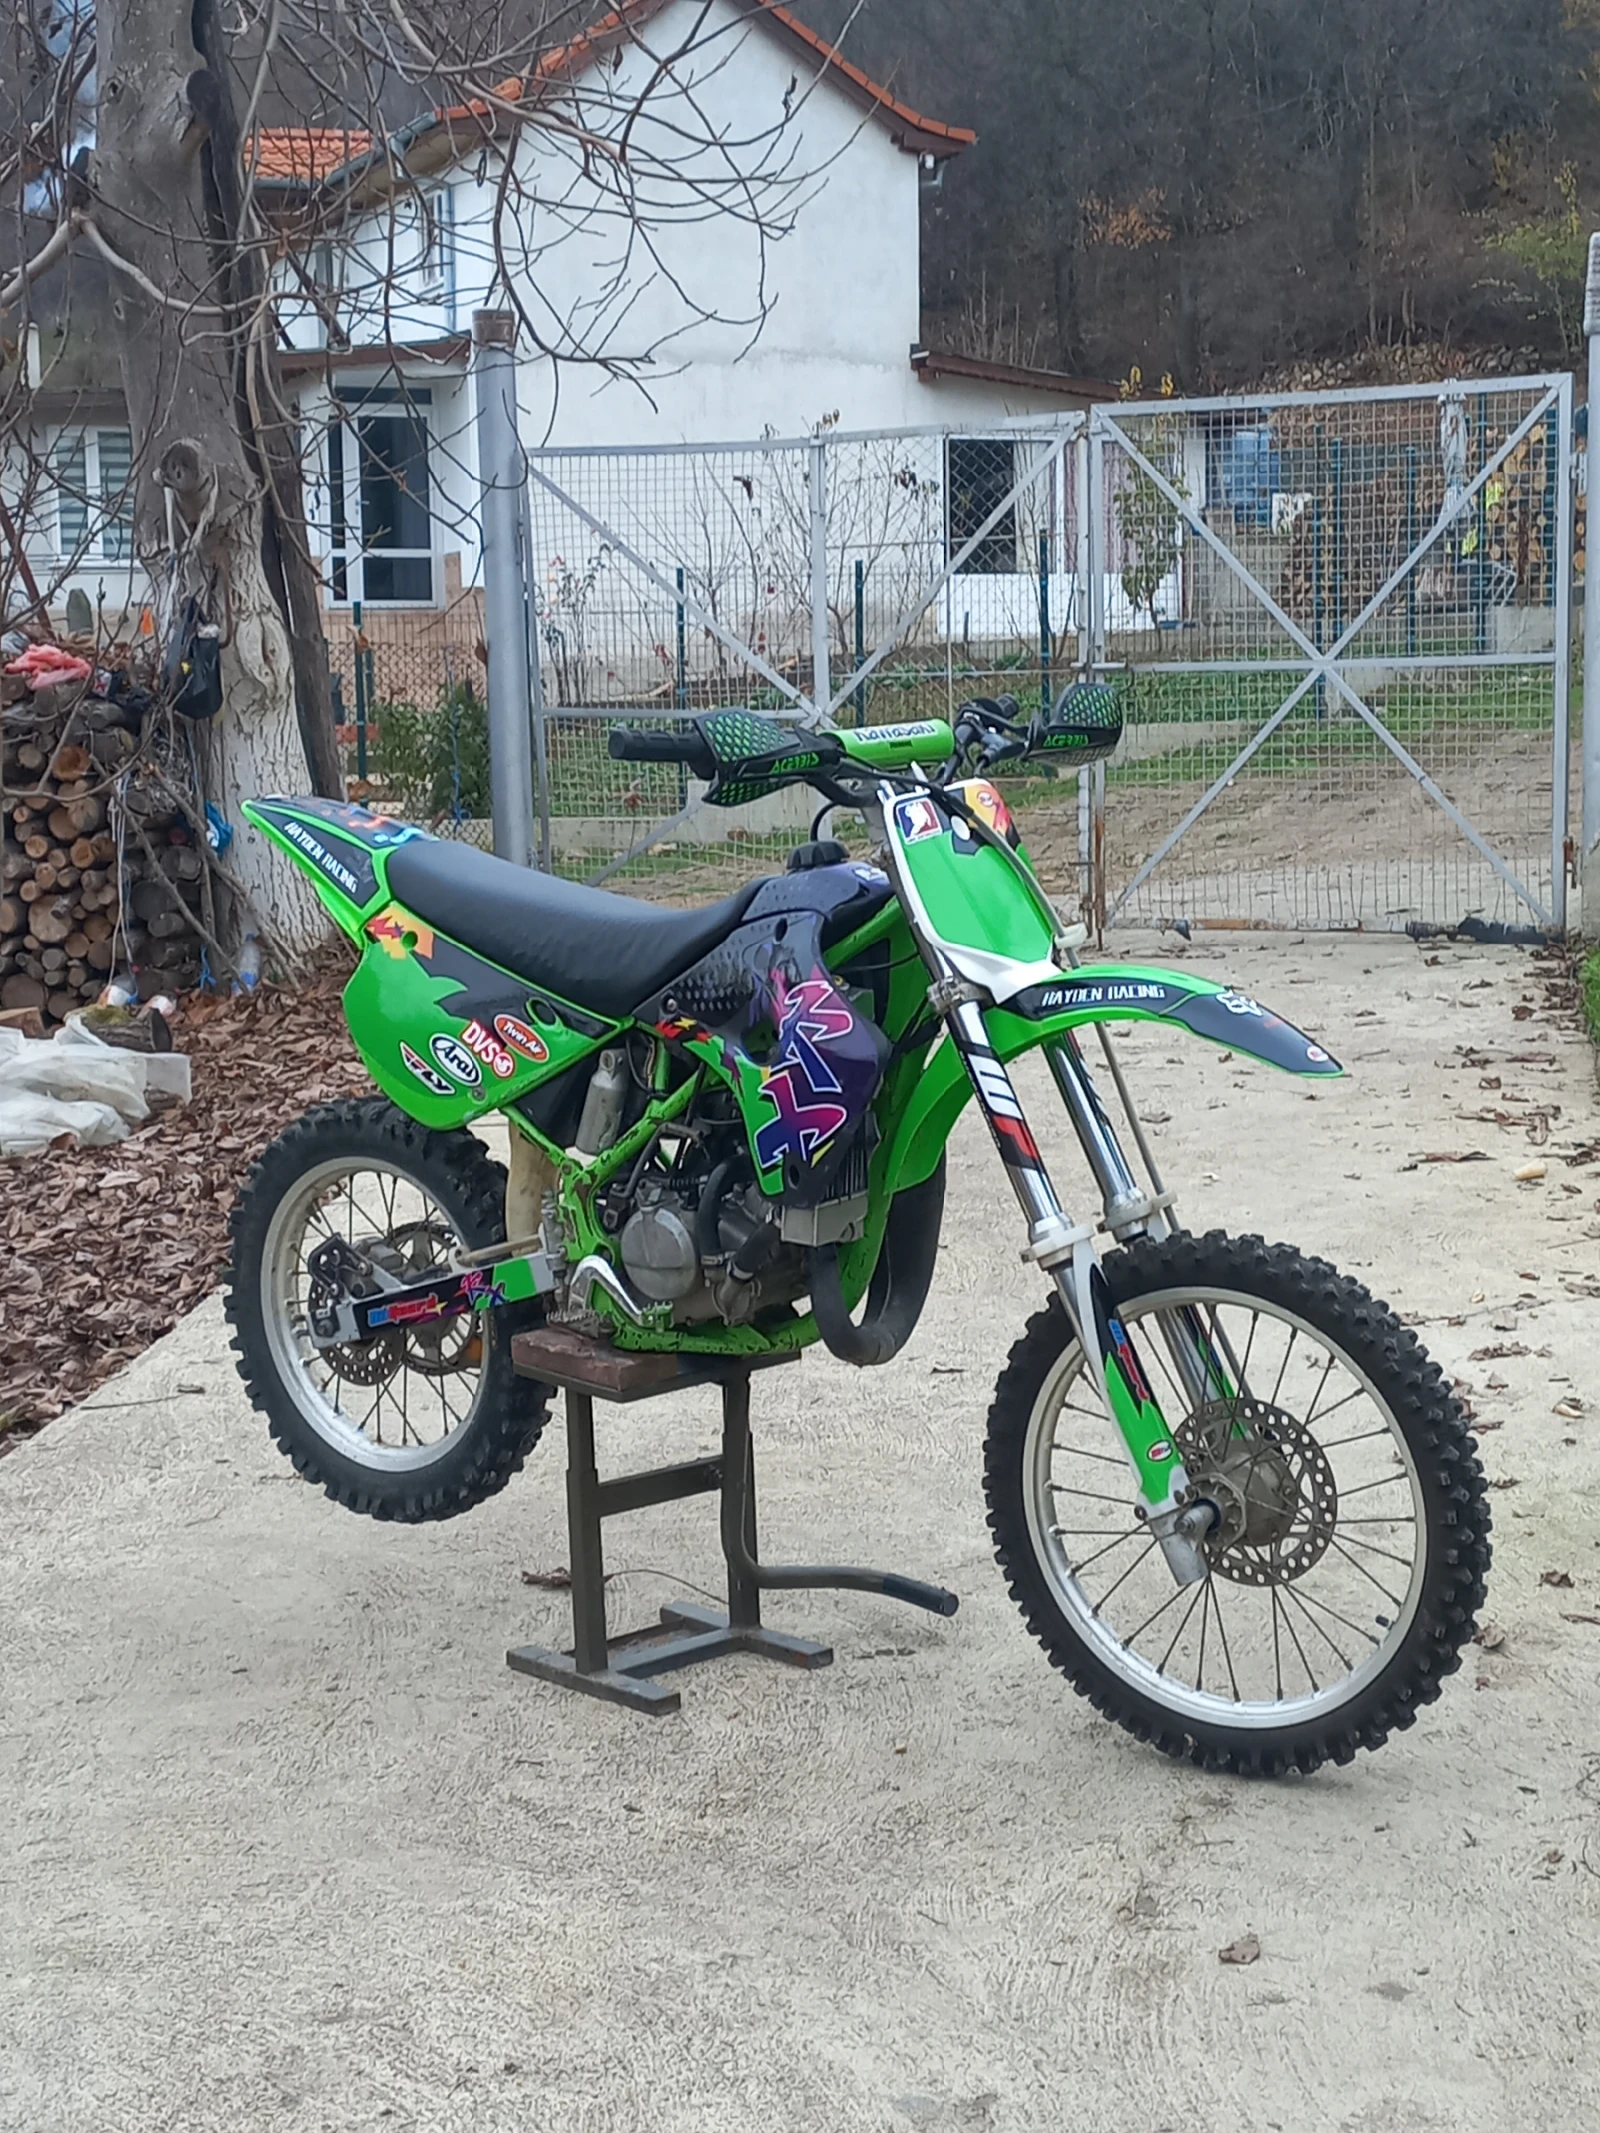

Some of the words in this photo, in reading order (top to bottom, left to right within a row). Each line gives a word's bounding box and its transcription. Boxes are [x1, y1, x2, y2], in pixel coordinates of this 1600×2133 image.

[284, 821, 325, 860] HAYDEN
[321, 852, 359, 894] RACING
[1042, 988, 1103, 1007] HAYDEN
[1107, 985, 1166, 1001] RACING
[435, 1038, 477, 1079] Arai
[461, 1020, 500, 1064] DVS
[503, 1021, 528, 1045] Twin
[525, 1039, 543, 1055] Air
